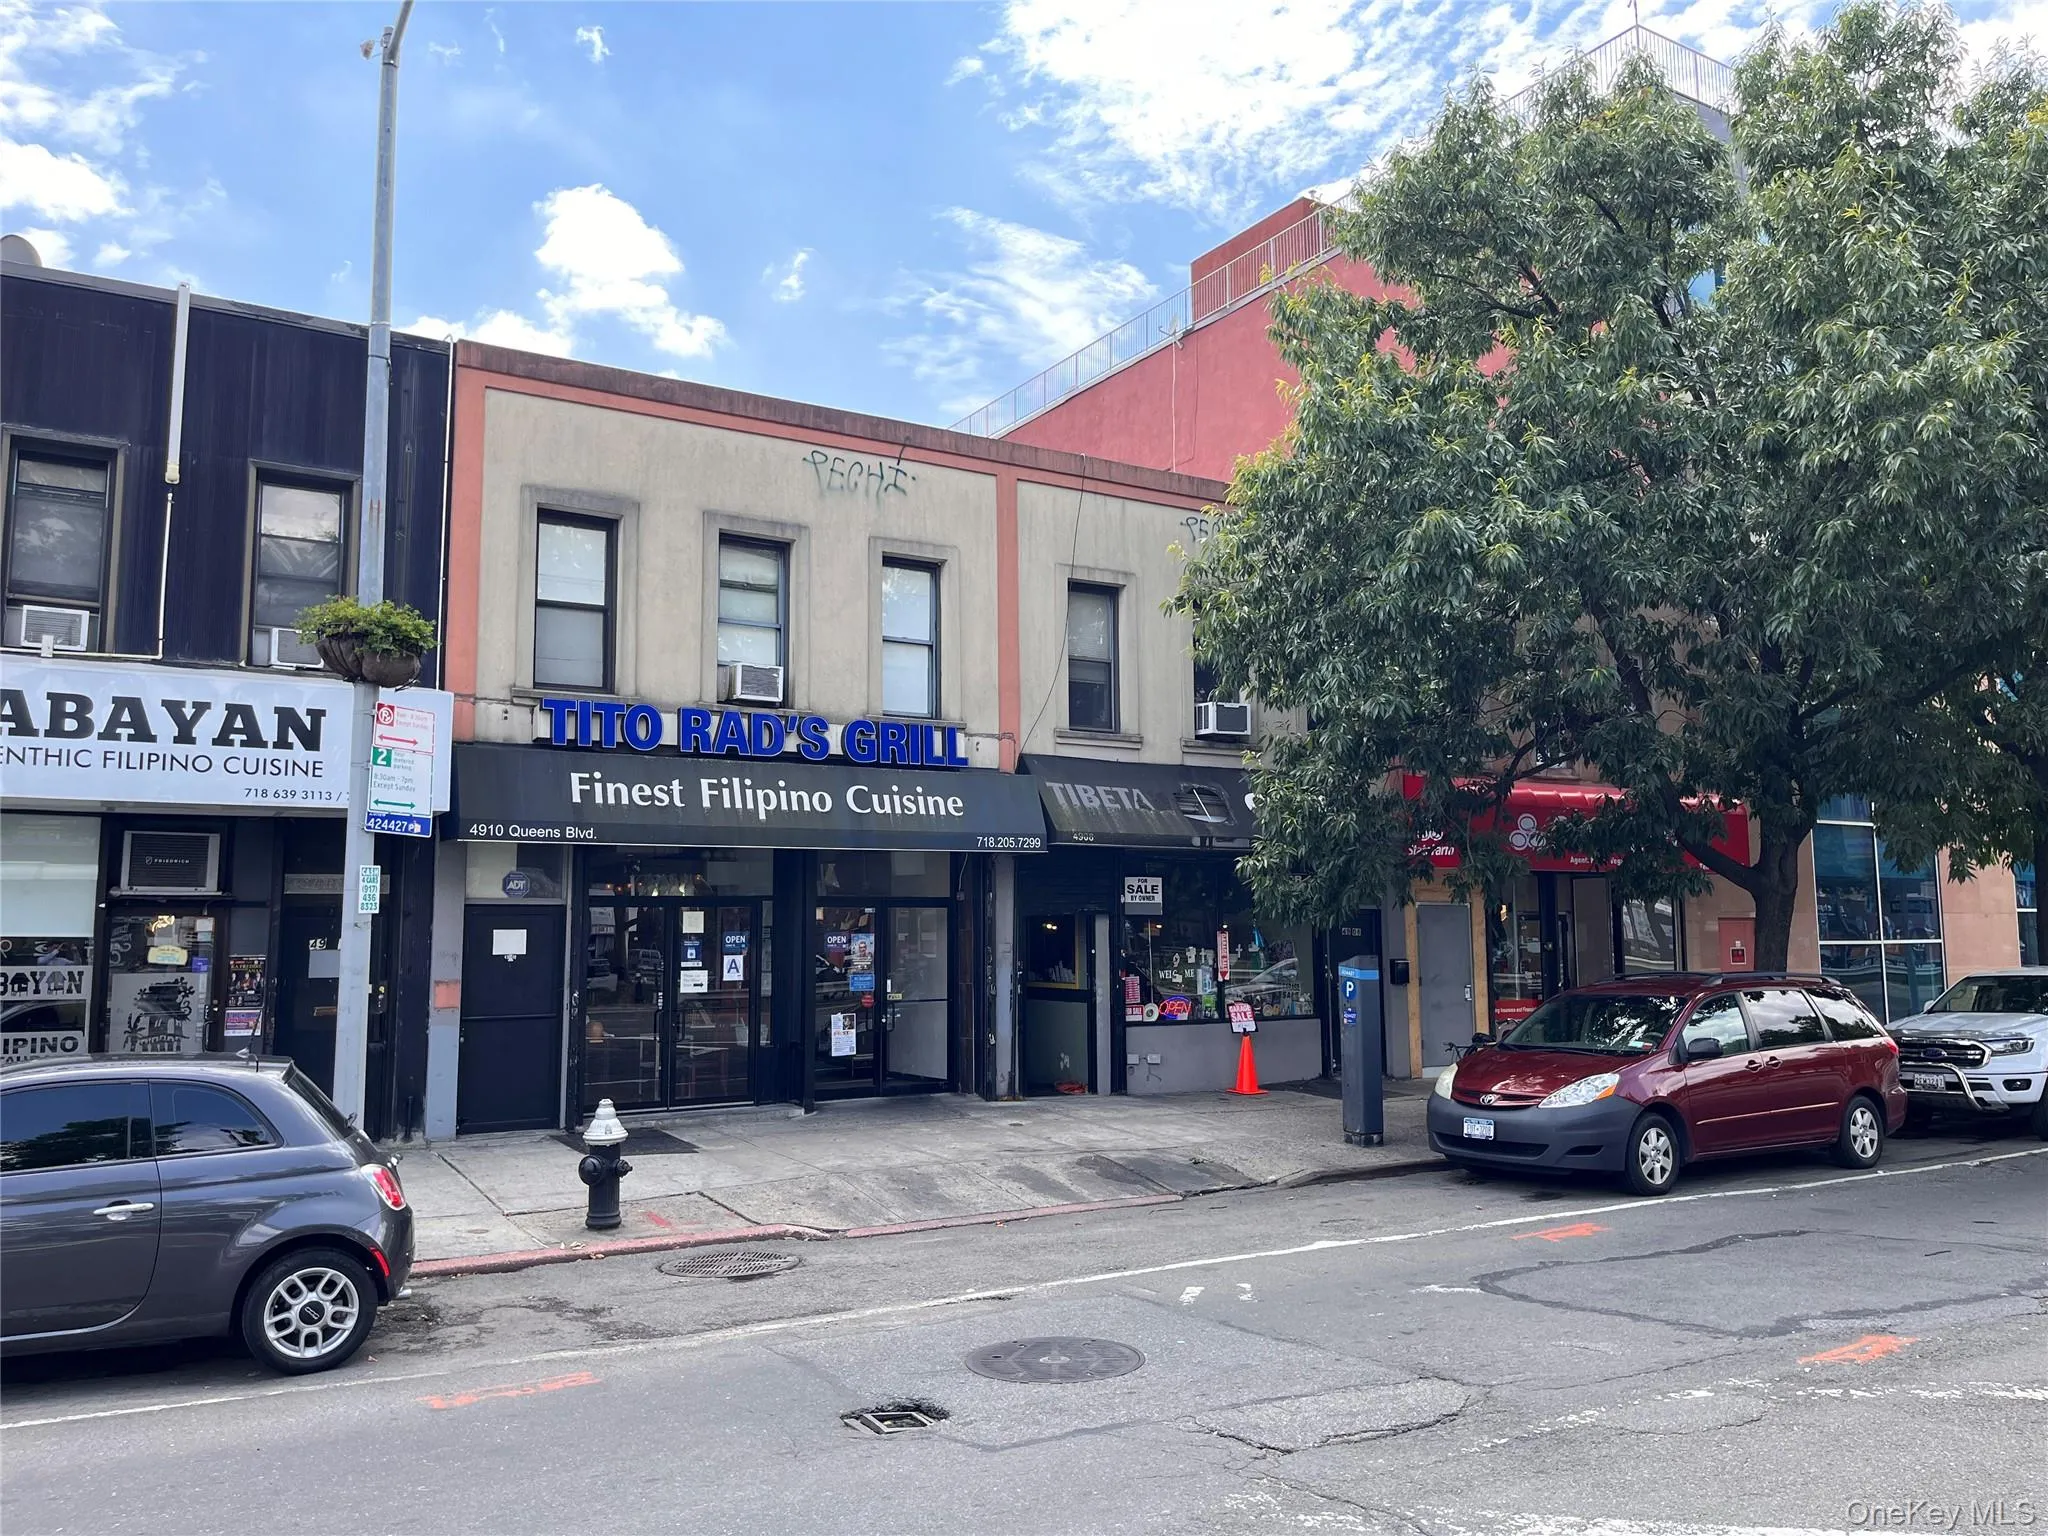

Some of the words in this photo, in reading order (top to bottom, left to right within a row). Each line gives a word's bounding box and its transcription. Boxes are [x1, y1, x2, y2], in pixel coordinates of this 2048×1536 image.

[543, 698, 664, 751] TITO
[679, 707, 830, 760] RAD'S
[844, 720, 969, 767] GRILL
[0, 746, 92, 768] NTHIC
[103, 751, 213, 773] FILIPINO
[223, 756, 324, 778] CUISINE
[376, 749, 387, 765] 2
[244, 788, 271, 798] 718
[273, 789, 297, 799] 639
[301, 790, 332, 801] 3113
[570, 771, 685, 807] Finest
[700, 777, 833, 820] Filipino
[846, 785, 964, 816] Cuisine
[367, 818, 408, 832] 424427
[469, 823, 504, 836] 4910
[509, 824, 561, 838] Queens
[565, 826, 597, 839] Blvd.
[977, 836, 1041, 848] 718.205.7299
[362, 885, 378, 894] (917)
[506, 880, 526, 890] ADT
[1127, 884, 1159, 895] SALE
[363, 894, 376, 902] 436
[360, 902, 378, 911] 8323
[725, 935, 746, 943] OPEN
[827, 935, 847, 944] OPEN
[727, 958, 740, 974] A
[1346, 981, 1354, 997] P
[1158, 1000, 1192, 1016] OPEN
[1231, 1012, 1254, 1022] SALE
